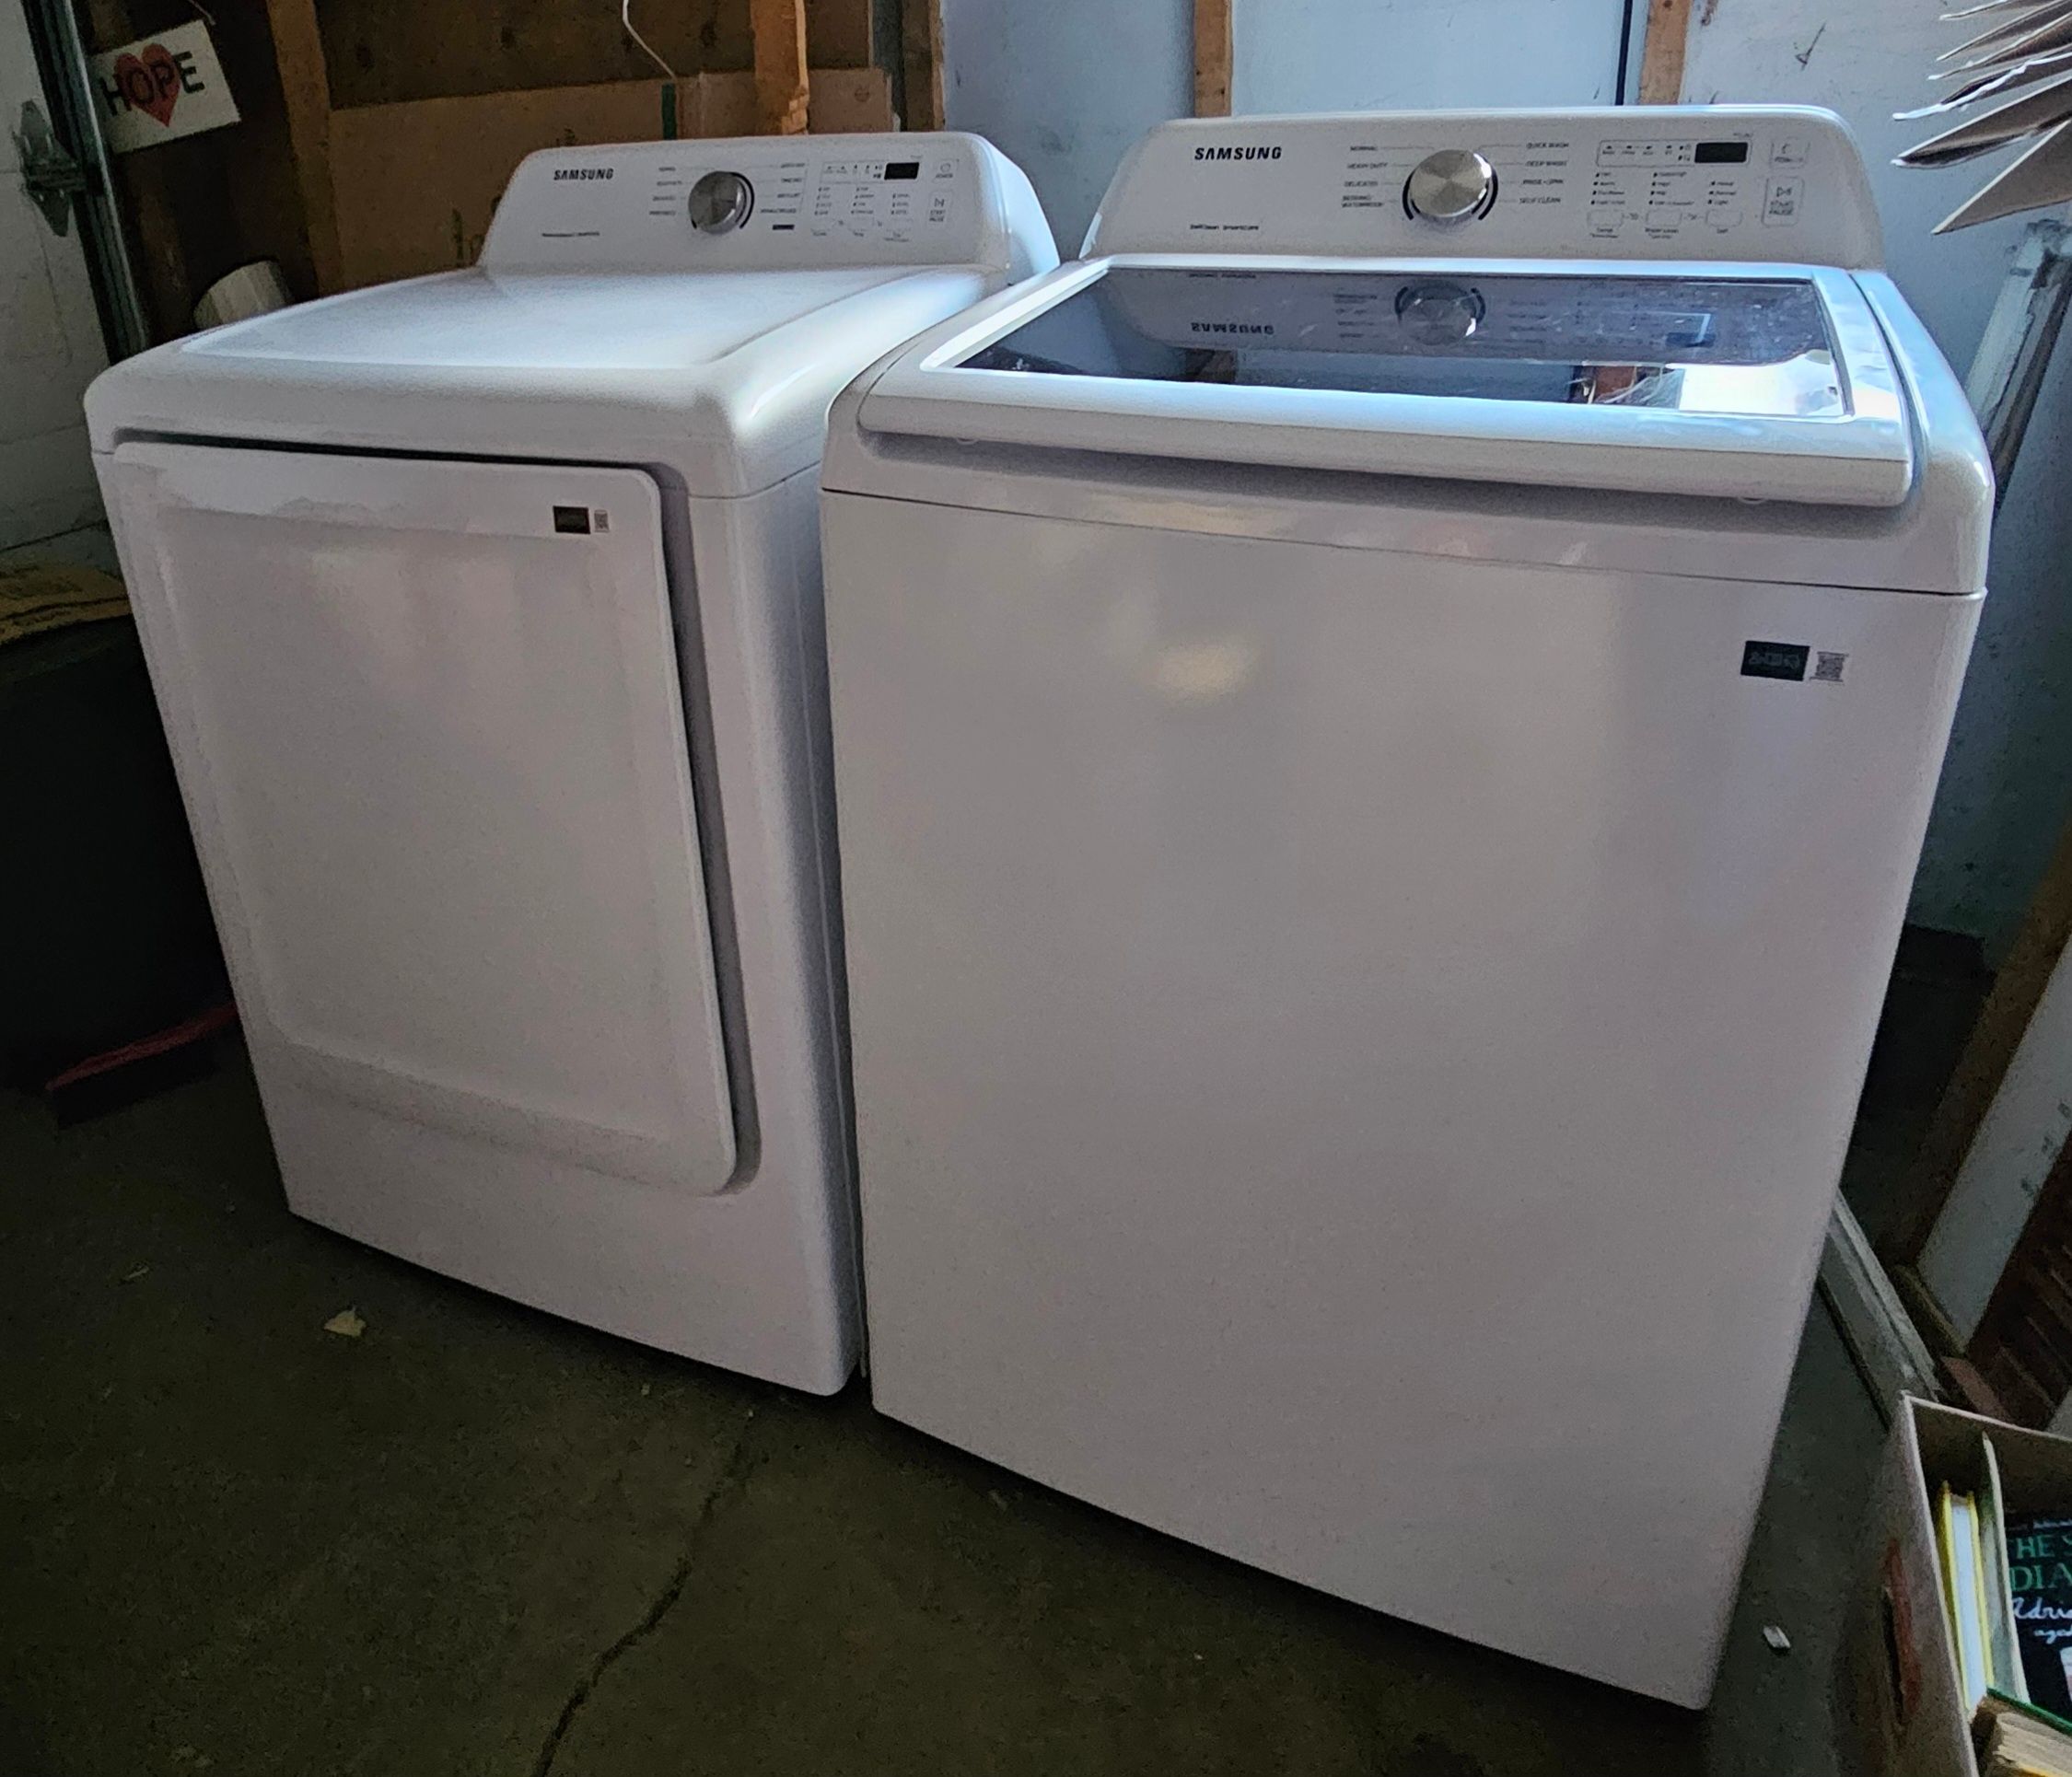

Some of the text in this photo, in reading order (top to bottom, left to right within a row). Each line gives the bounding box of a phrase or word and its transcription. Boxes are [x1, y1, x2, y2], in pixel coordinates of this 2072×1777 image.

[100, 51, 204, 116] HOPE
[1194, 146, 1282, 160] SAMSUNG
[553, 168, 614, 180] SAMSUNG
